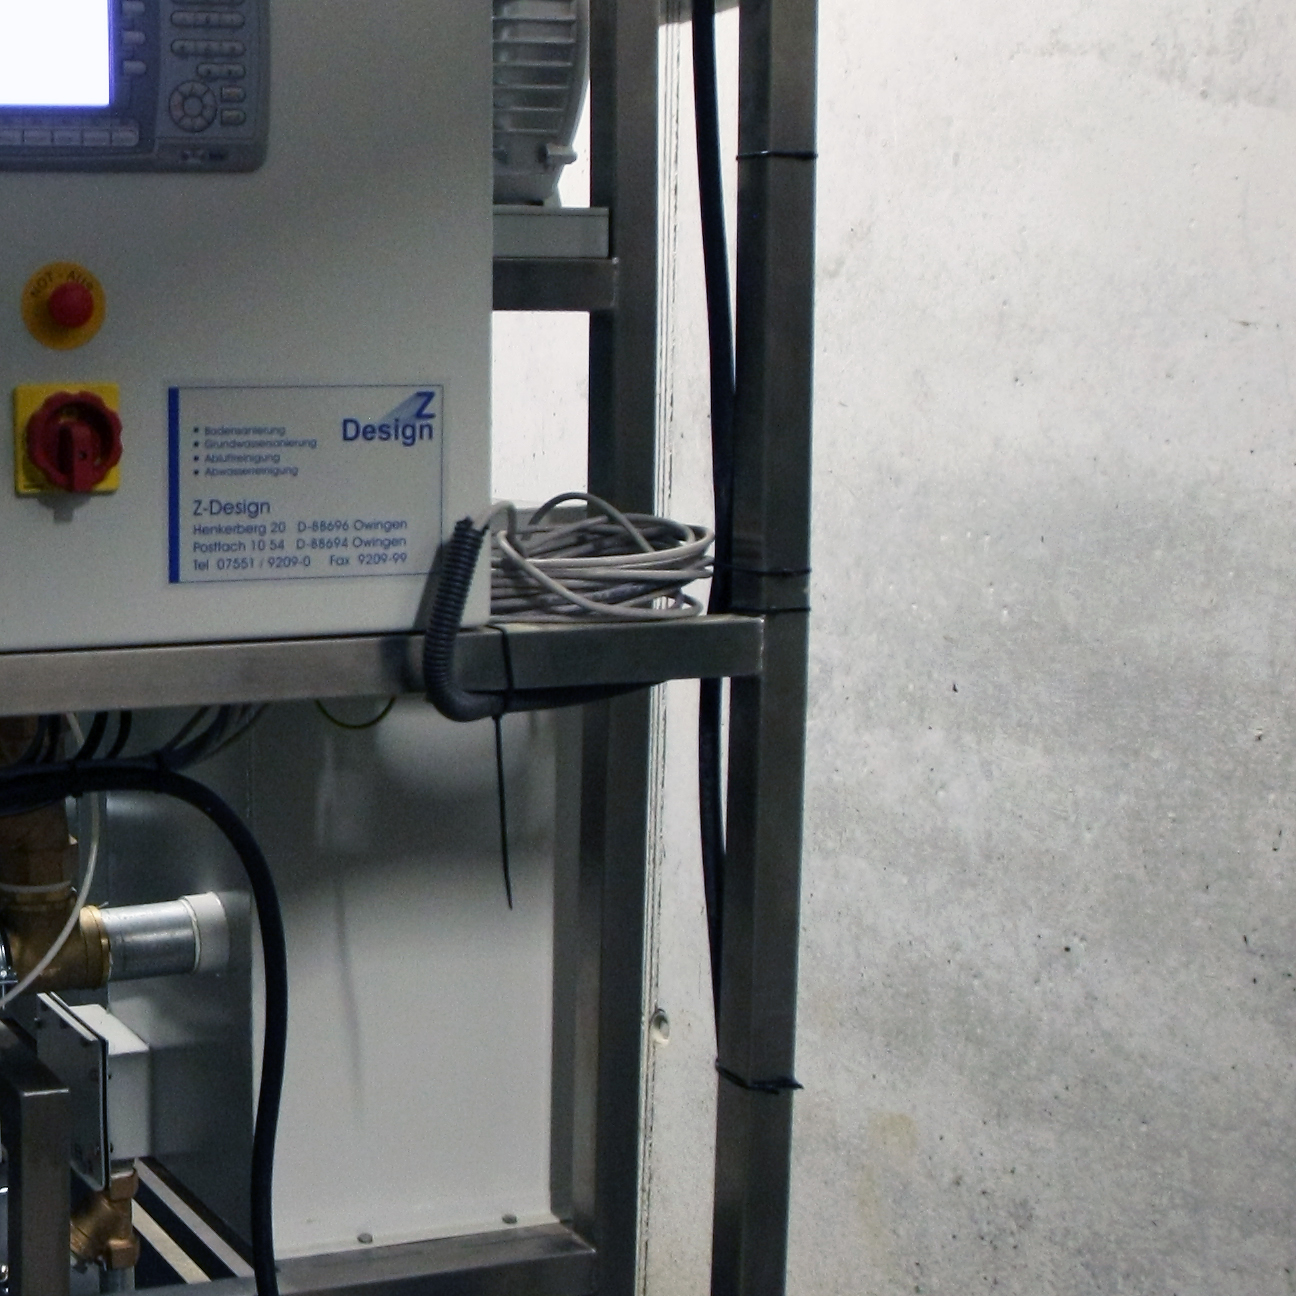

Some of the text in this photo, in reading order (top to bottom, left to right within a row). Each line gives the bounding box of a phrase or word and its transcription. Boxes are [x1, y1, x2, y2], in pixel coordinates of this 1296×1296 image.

[416, 391, 436, 419] Z
[342, 418, 434, 447] Design
[193, 499, 271, 518] Z-Design
[193, 519, 408, 536] Henkerberg 20 D-88696 Owingen
[193, 536, 407, 553] Postfach 10 54 D-88694 Owingen
[216, 557, 255, 570] 07551
[267, 555, 311, 568] 9209-0
[330, 554, 351, 566] Fax
[358, 552, 408, 566] 9209-99
